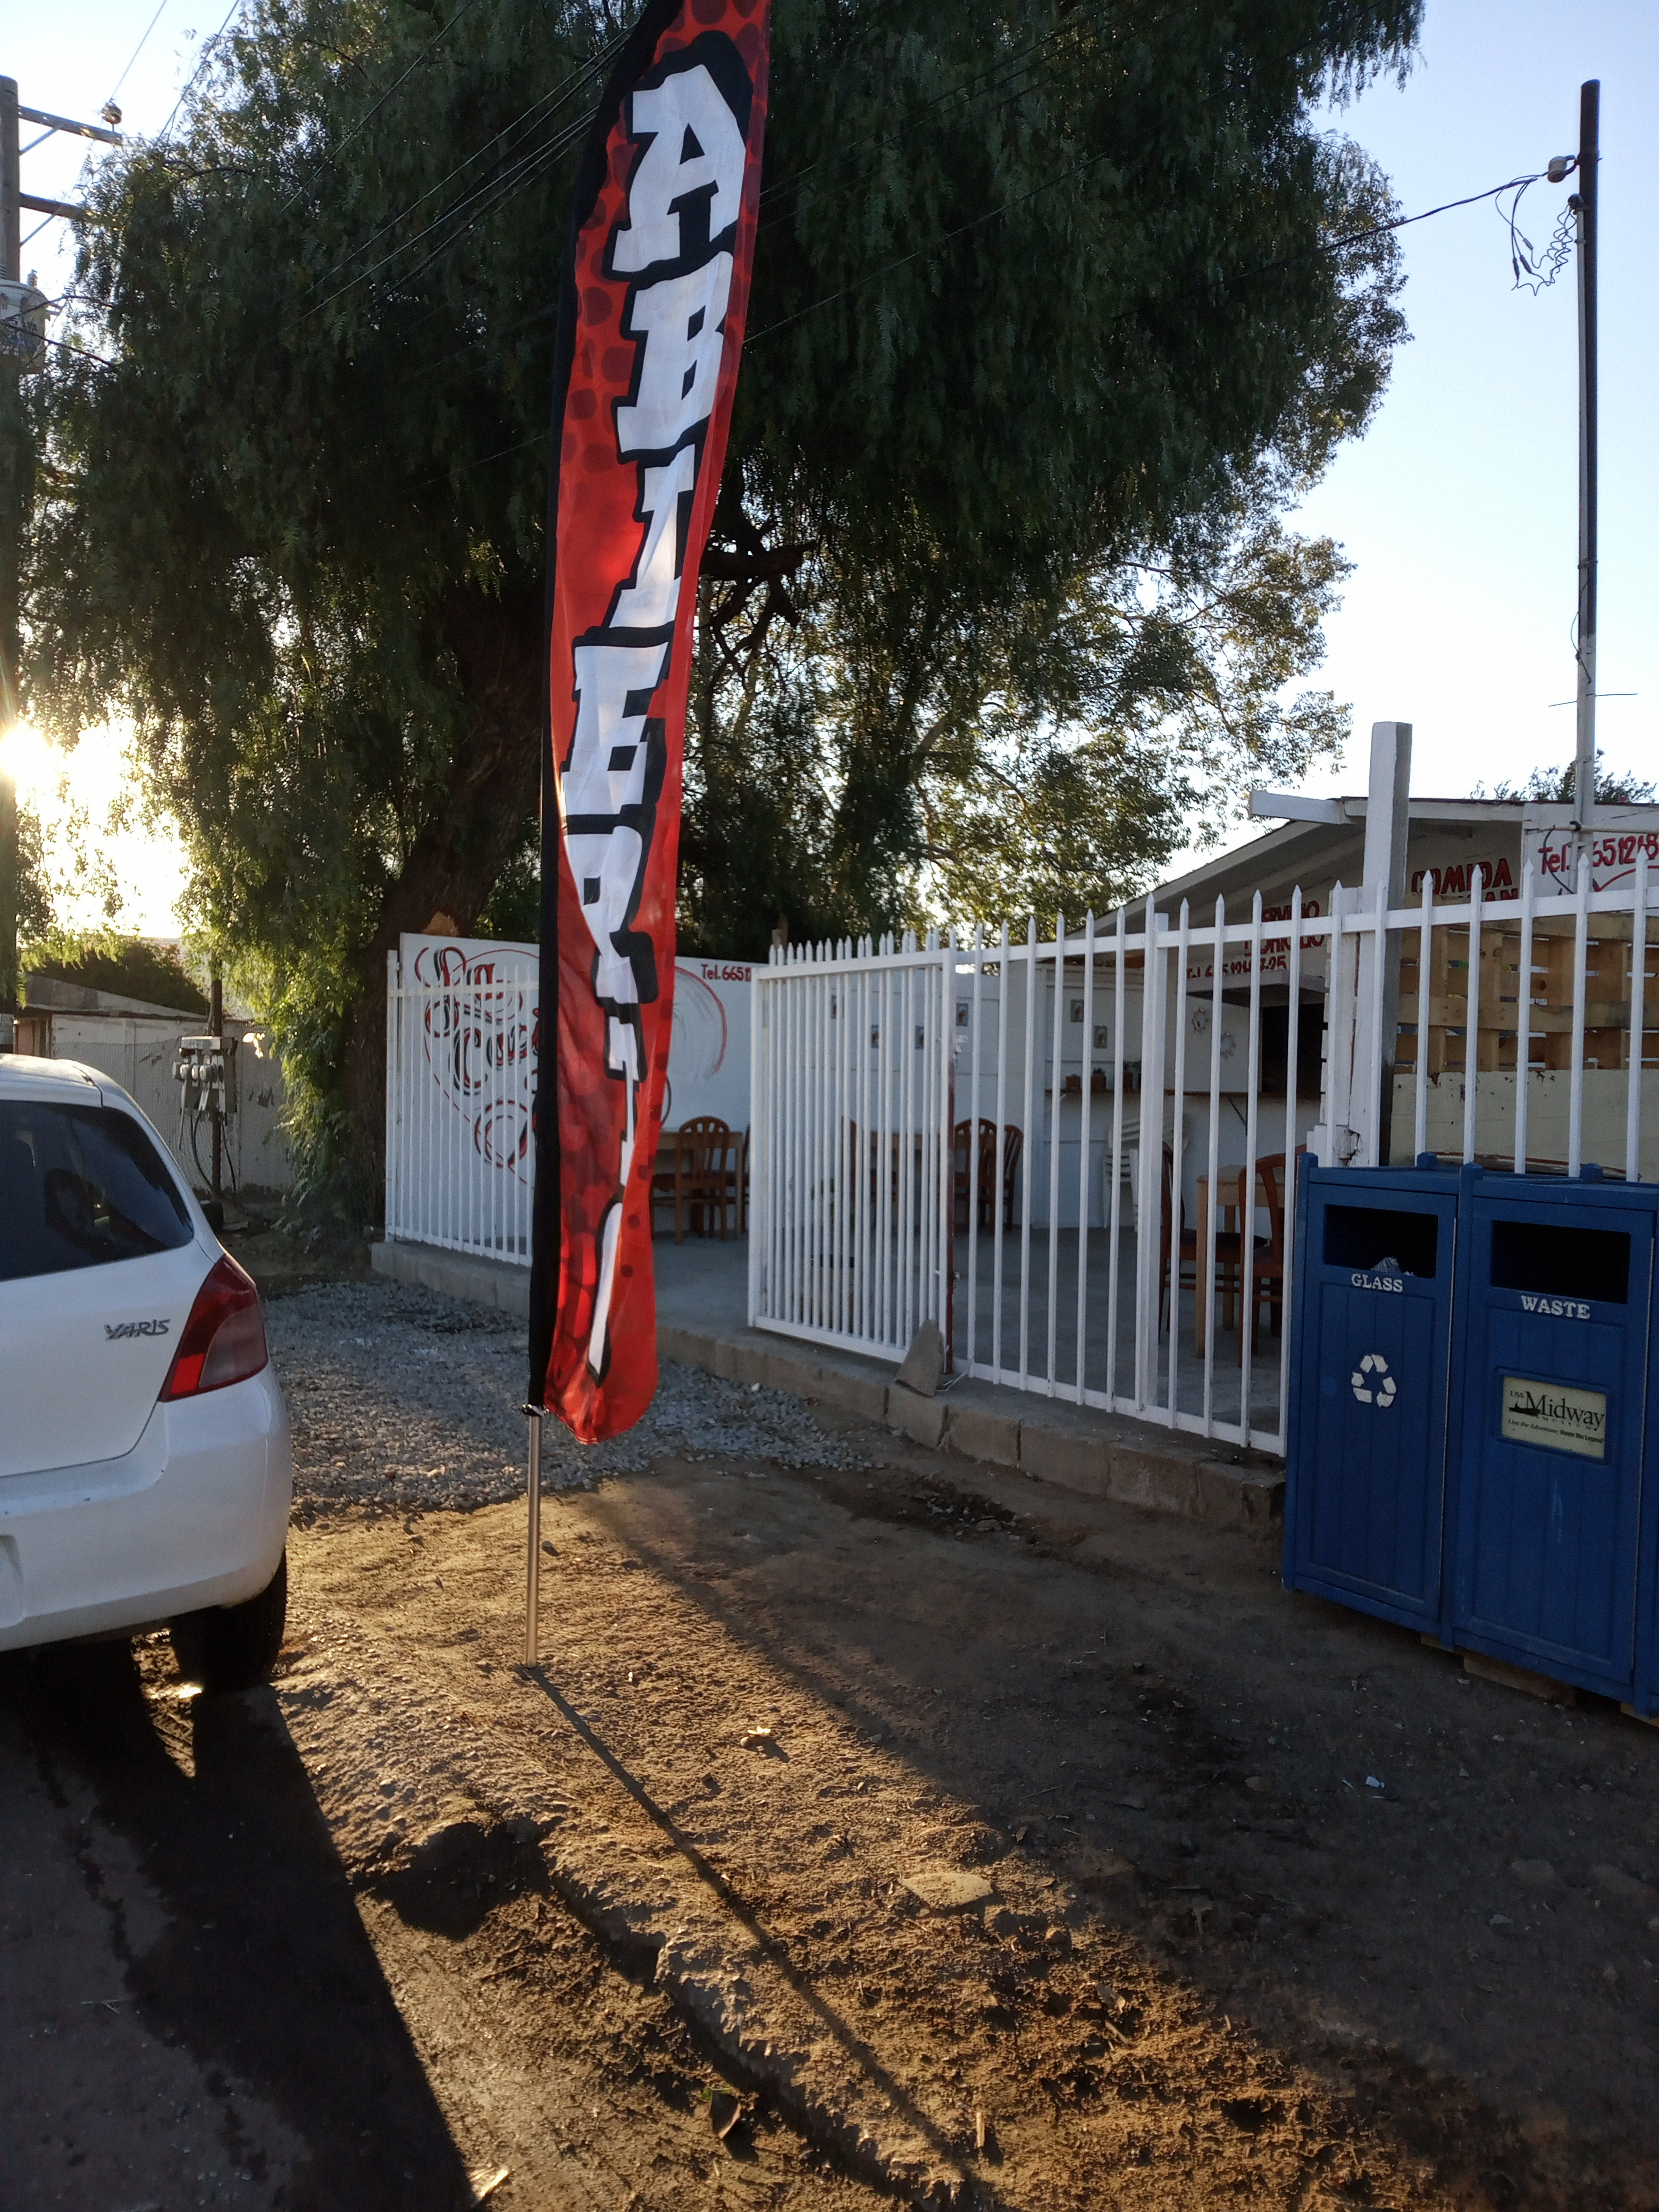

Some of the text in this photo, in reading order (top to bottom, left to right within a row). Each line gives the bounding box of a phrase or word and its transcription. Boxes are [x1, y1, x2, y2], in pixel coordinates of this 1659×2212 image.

[1538, 844, 1570, 875] Tel.
[1412, 858, 1512, 895] COMIDA
[1351, 1273, 1403, 1293] GLASS
[1521, 1295, 1591, 1319] WASTE
[104, 1319, 171, 1340] YARIS
[1525, 1391, 1605, 1431] Midway
